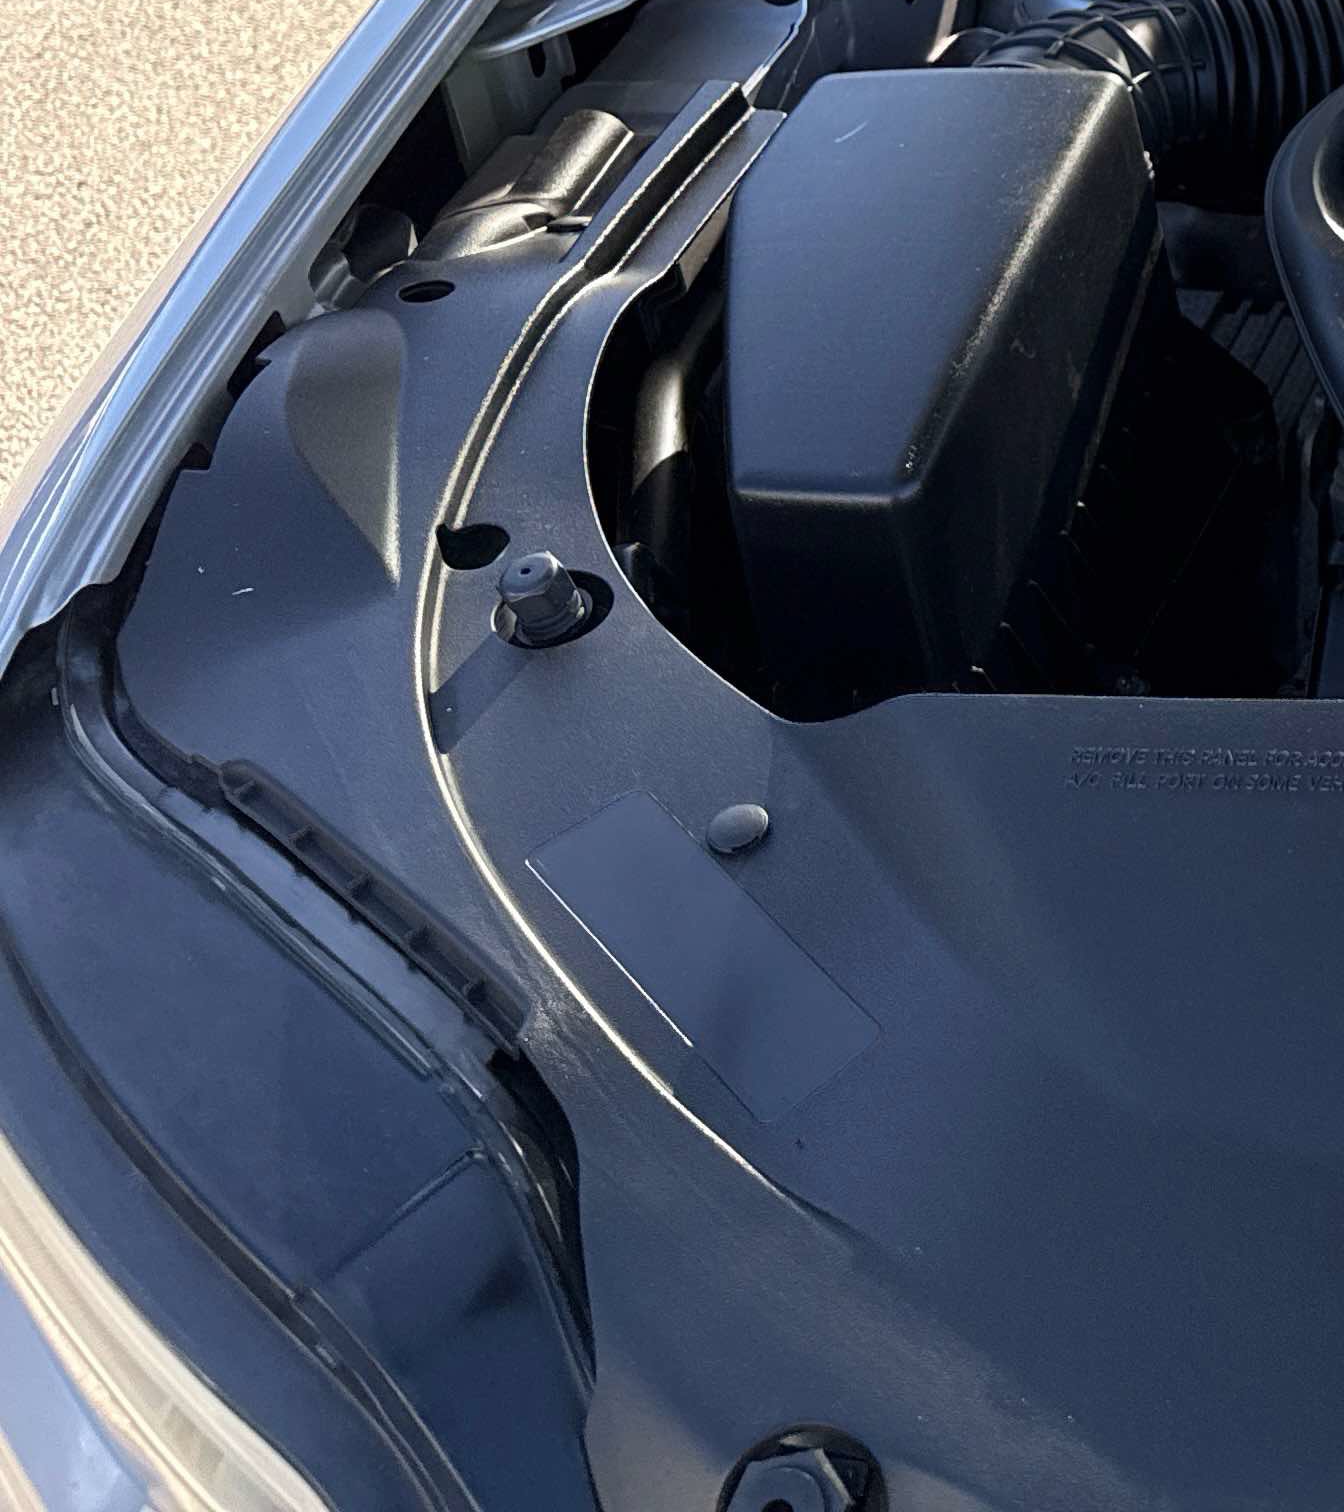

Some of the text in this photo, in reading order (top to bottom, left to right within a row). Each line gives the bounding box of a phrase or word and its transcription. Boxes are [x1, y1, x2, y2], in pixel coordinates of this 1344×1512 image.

[1071, 746, 1149, 765] REMOVE
[1152, 747, 1196, 765] THIS
[1201, 748, 1257, 766] PANEL
[1263, 749, 1302, 767] FOR
[1111, 770, 1147, 788] FILL
[1156, 771, 1207, 789] PORT
[1245, 772, 1302, 790] SOME
